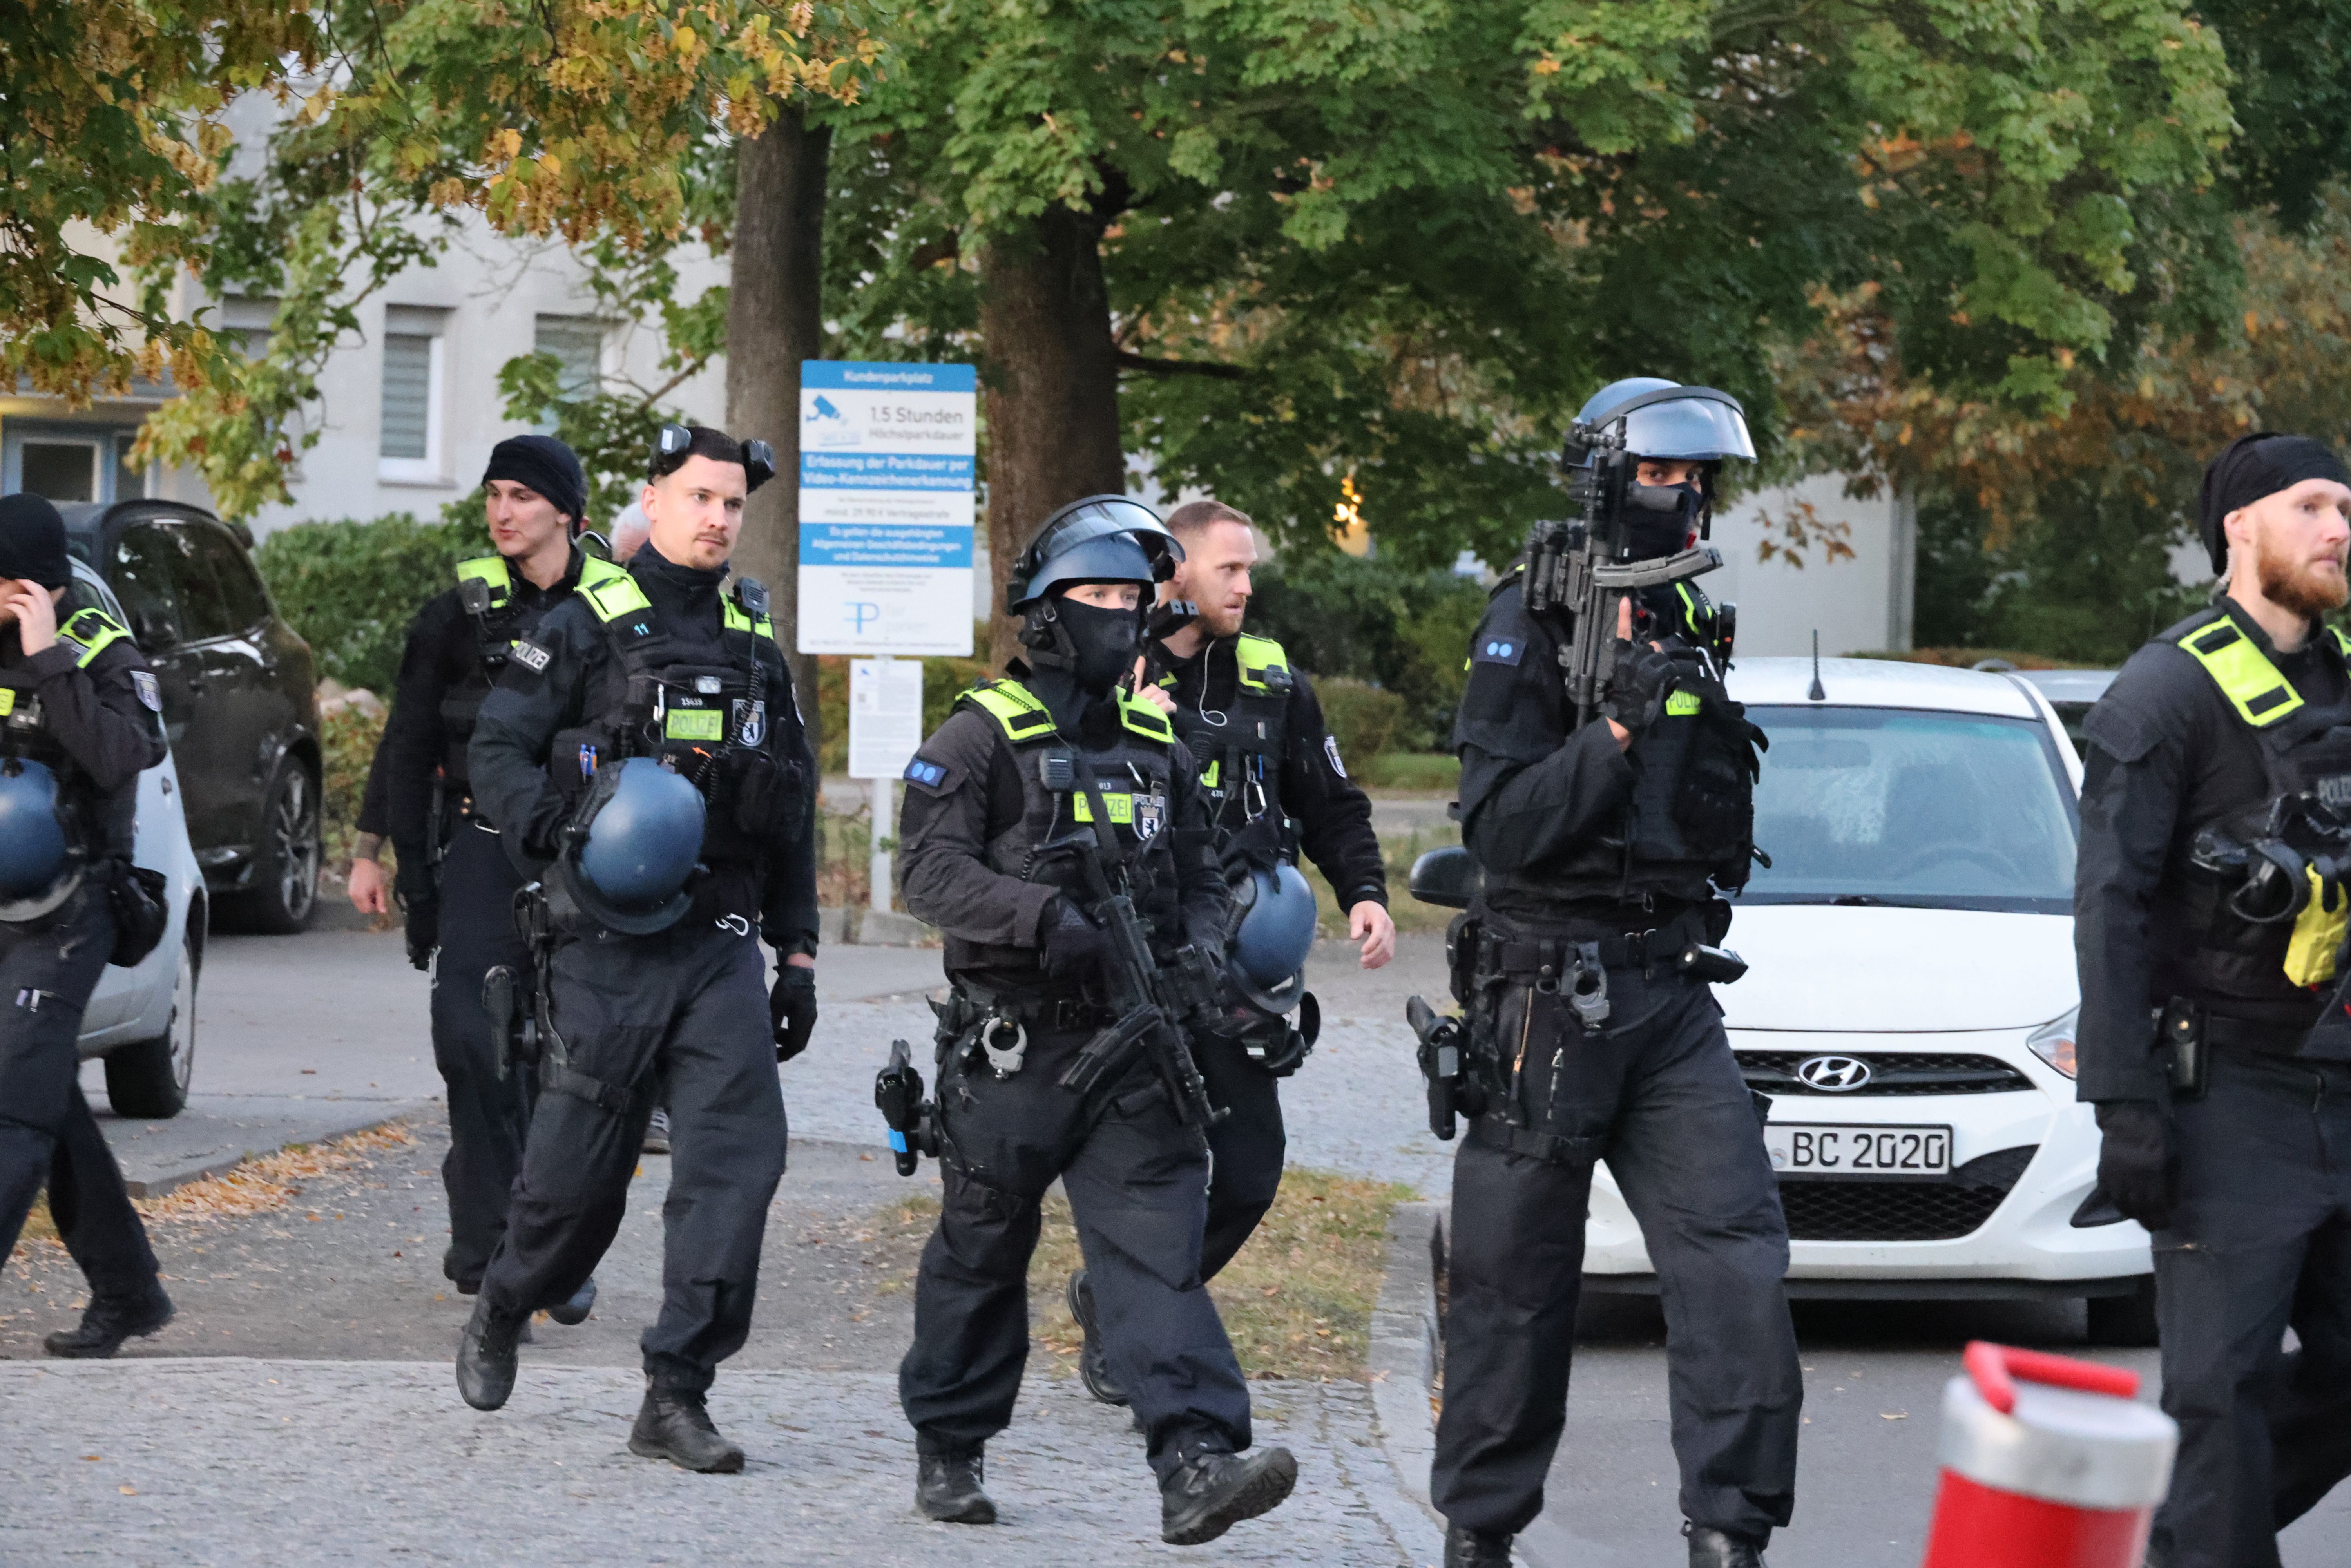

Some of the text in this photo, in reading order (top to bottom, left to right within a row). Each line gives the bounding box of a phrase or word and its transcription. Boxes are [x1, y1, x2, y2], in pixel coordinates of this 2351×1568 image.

[896, 406, 964, 423] Stunden
[1078, 798, 1128, 817] PZEI
[1793, 1132, 1945, 1168] BC 2020
